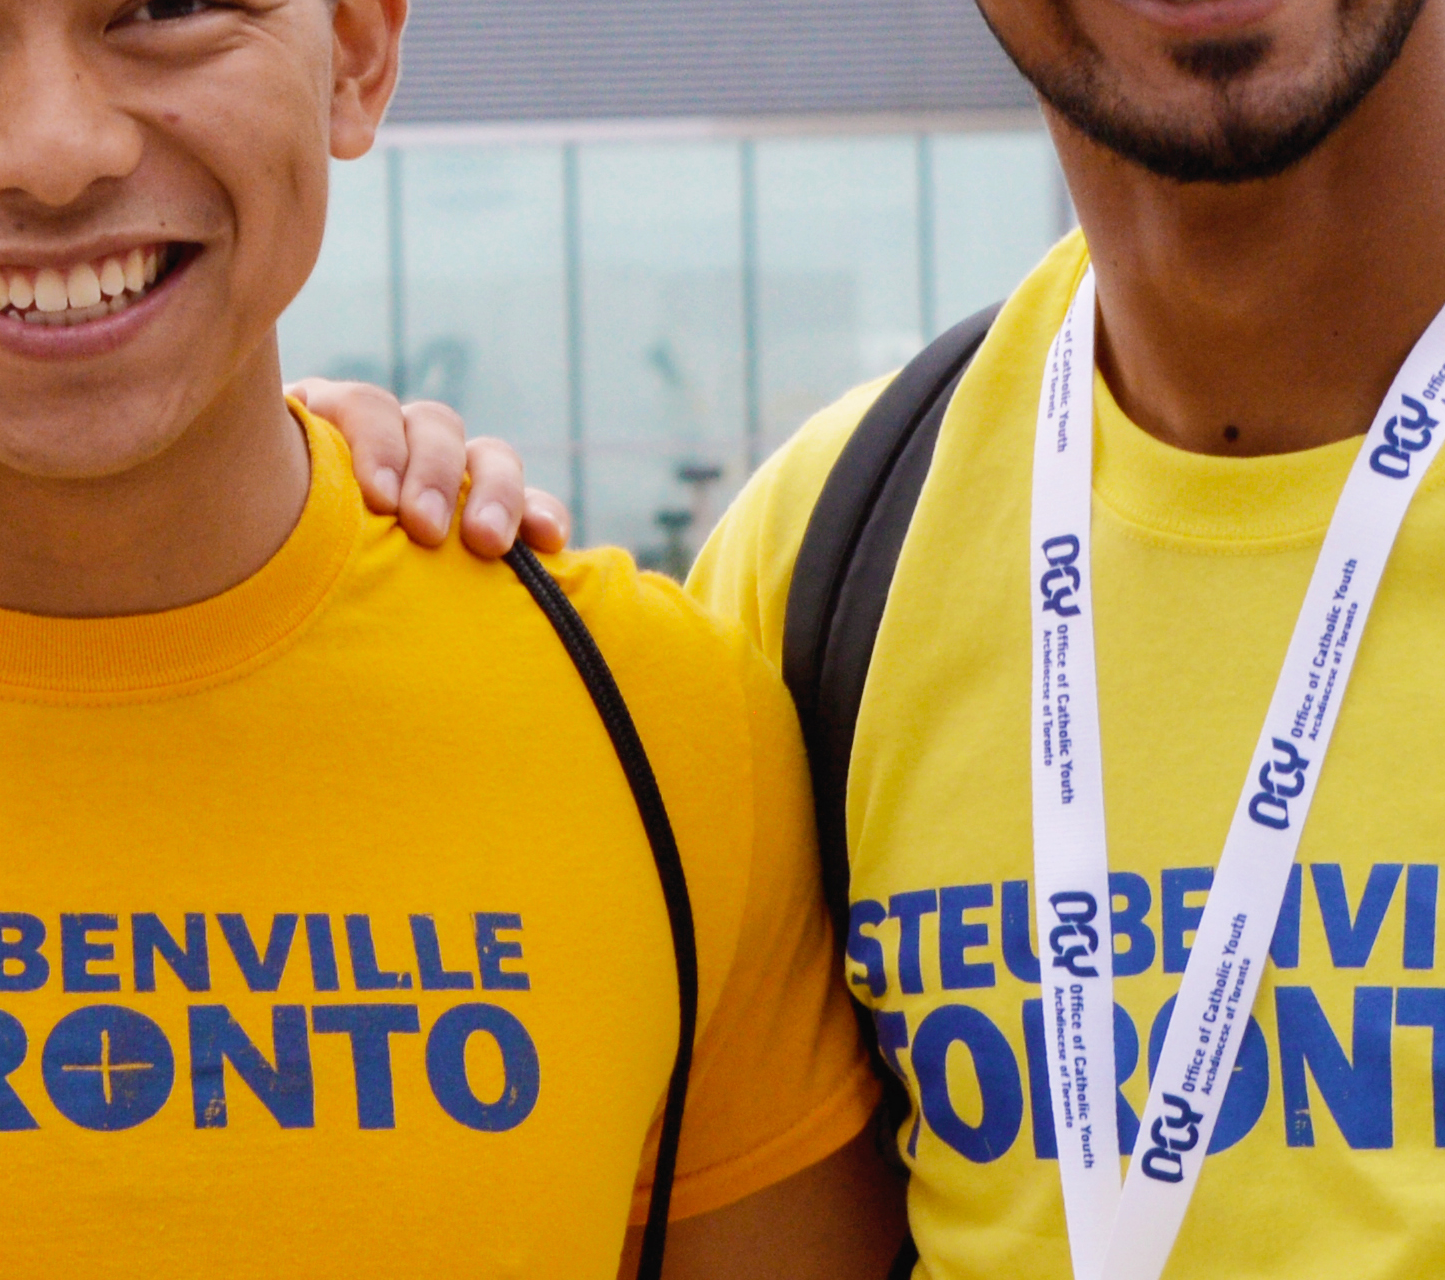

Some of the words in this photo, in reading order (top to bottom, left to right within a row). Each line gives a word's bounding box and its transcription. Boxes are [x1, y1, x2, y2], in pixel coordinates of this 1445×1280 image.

[1060, 349, 1072, 408] Catholic
[1057, 410, 1069, 453] Youth
[1333, 557, 1358, 601] Youth
[1057, 624, 1068, 668] Office
[1312, 602, 1341, 668] Catholic
[1336, 601, 1359, 647] Toronto
[1043, 630, 1051, 699] Archdiocese
[1334, 647, 1344, 665] of
[1057, 674, 1068, 690] of
[1309, 670, 1319, 689] of
[1058, 693, 1072, 756] Catholic
[1291, 691, 1315, 739] Office
[1309, 668, 1336, 740] Archdiocese
[1043, 721, 1052, 767] Toronto
[1059, 760, 1073, 805] Youth
[1222, 912, 1247, 960] Youth
[1202, 961, 1231, 1023] Catholic
[1229, 958, 1251, 1004] Toronto
[1054, 986, 1065, 1060] Archdiocese
[1069, 984, 1082, 1028] Office
[1225, 1004, 1236, 1020] of
[1073, 1033, 1084, 1048] of
[1200, 1027, 1212, 1047] of
[1201, 1024, 1231, 1096] Archdiocese
[1060, 1065, 1068, 1077] of
[1074, 1056, 1089, 1121] Catholic
[1183, 1047, 1206, 1093] Office
[1061, 1080, 1073, 1129] Toronto
[1081, 1124, 1094, 1169] Youth
